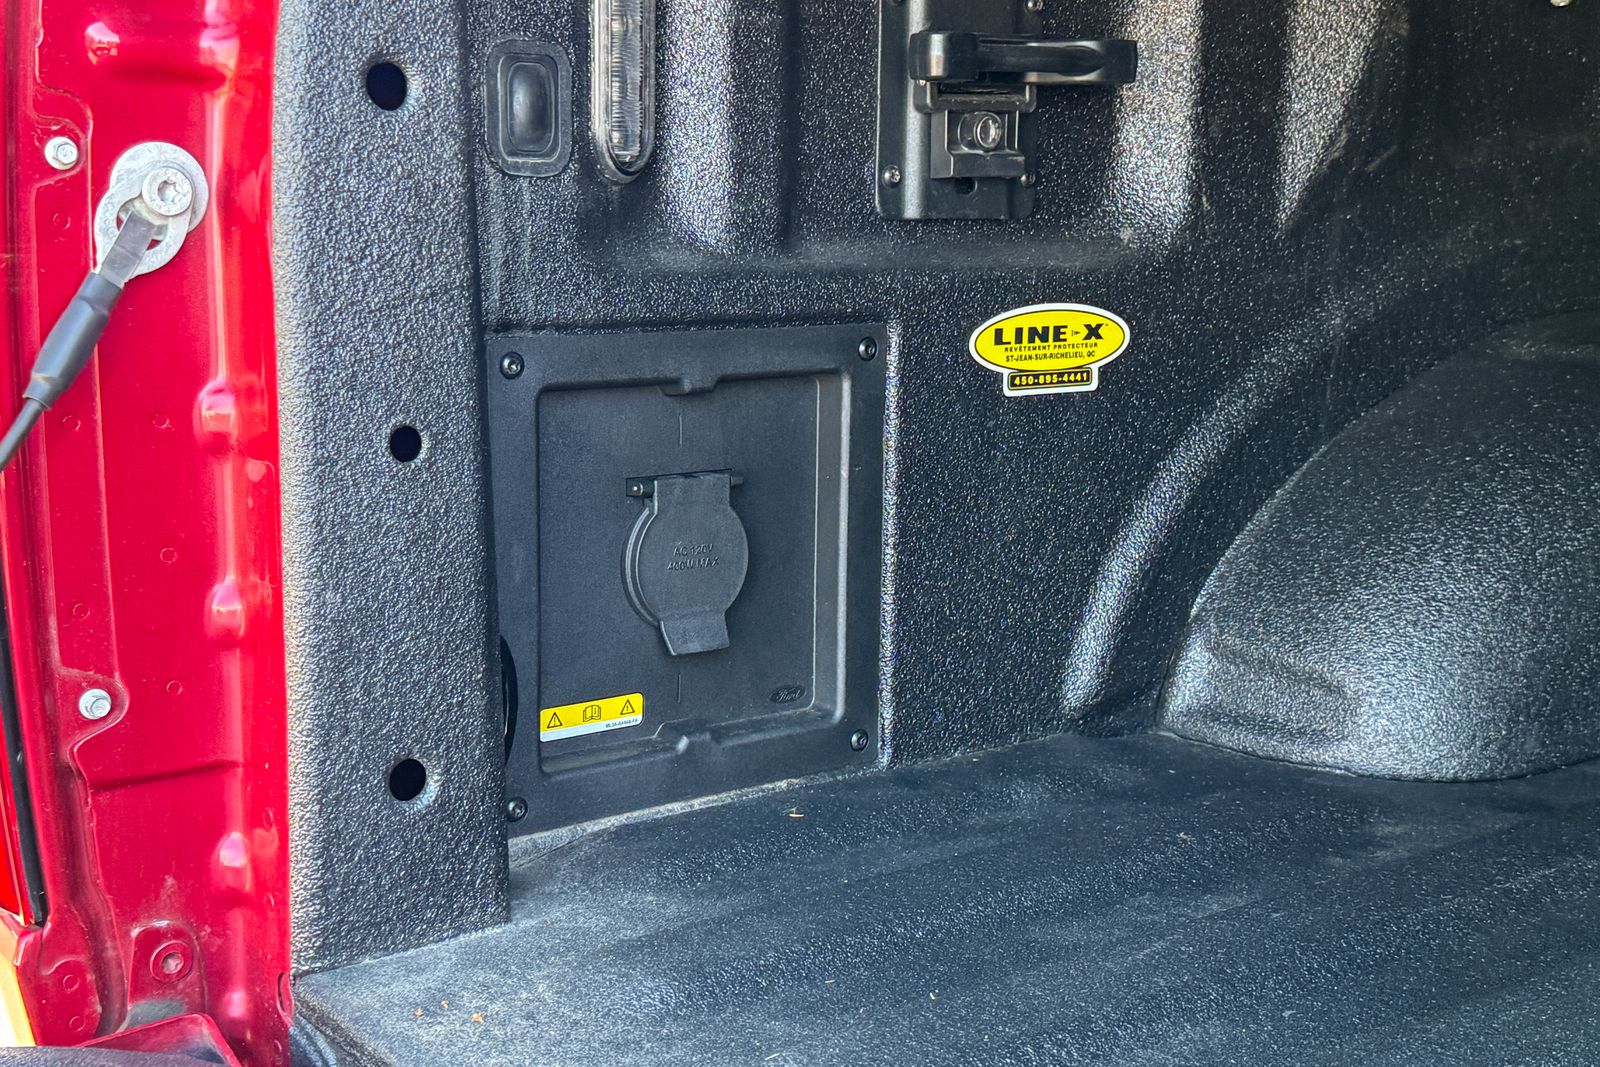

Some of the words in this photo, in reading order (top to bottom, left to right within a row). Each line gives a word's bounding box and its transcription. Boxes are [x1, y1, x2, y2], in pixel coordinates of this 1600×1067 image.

[1053, 342, 1098, 350] PROTECTEUR
[1087, 350, 1096, 358] QC
[672, 546, 687, 557] AC
[690, 543, 713, 556] 120V
[667, 559, 694, 571] 400W
[695, 556, 720, 569] MAX
[776, 687, 800, 703] Ford
